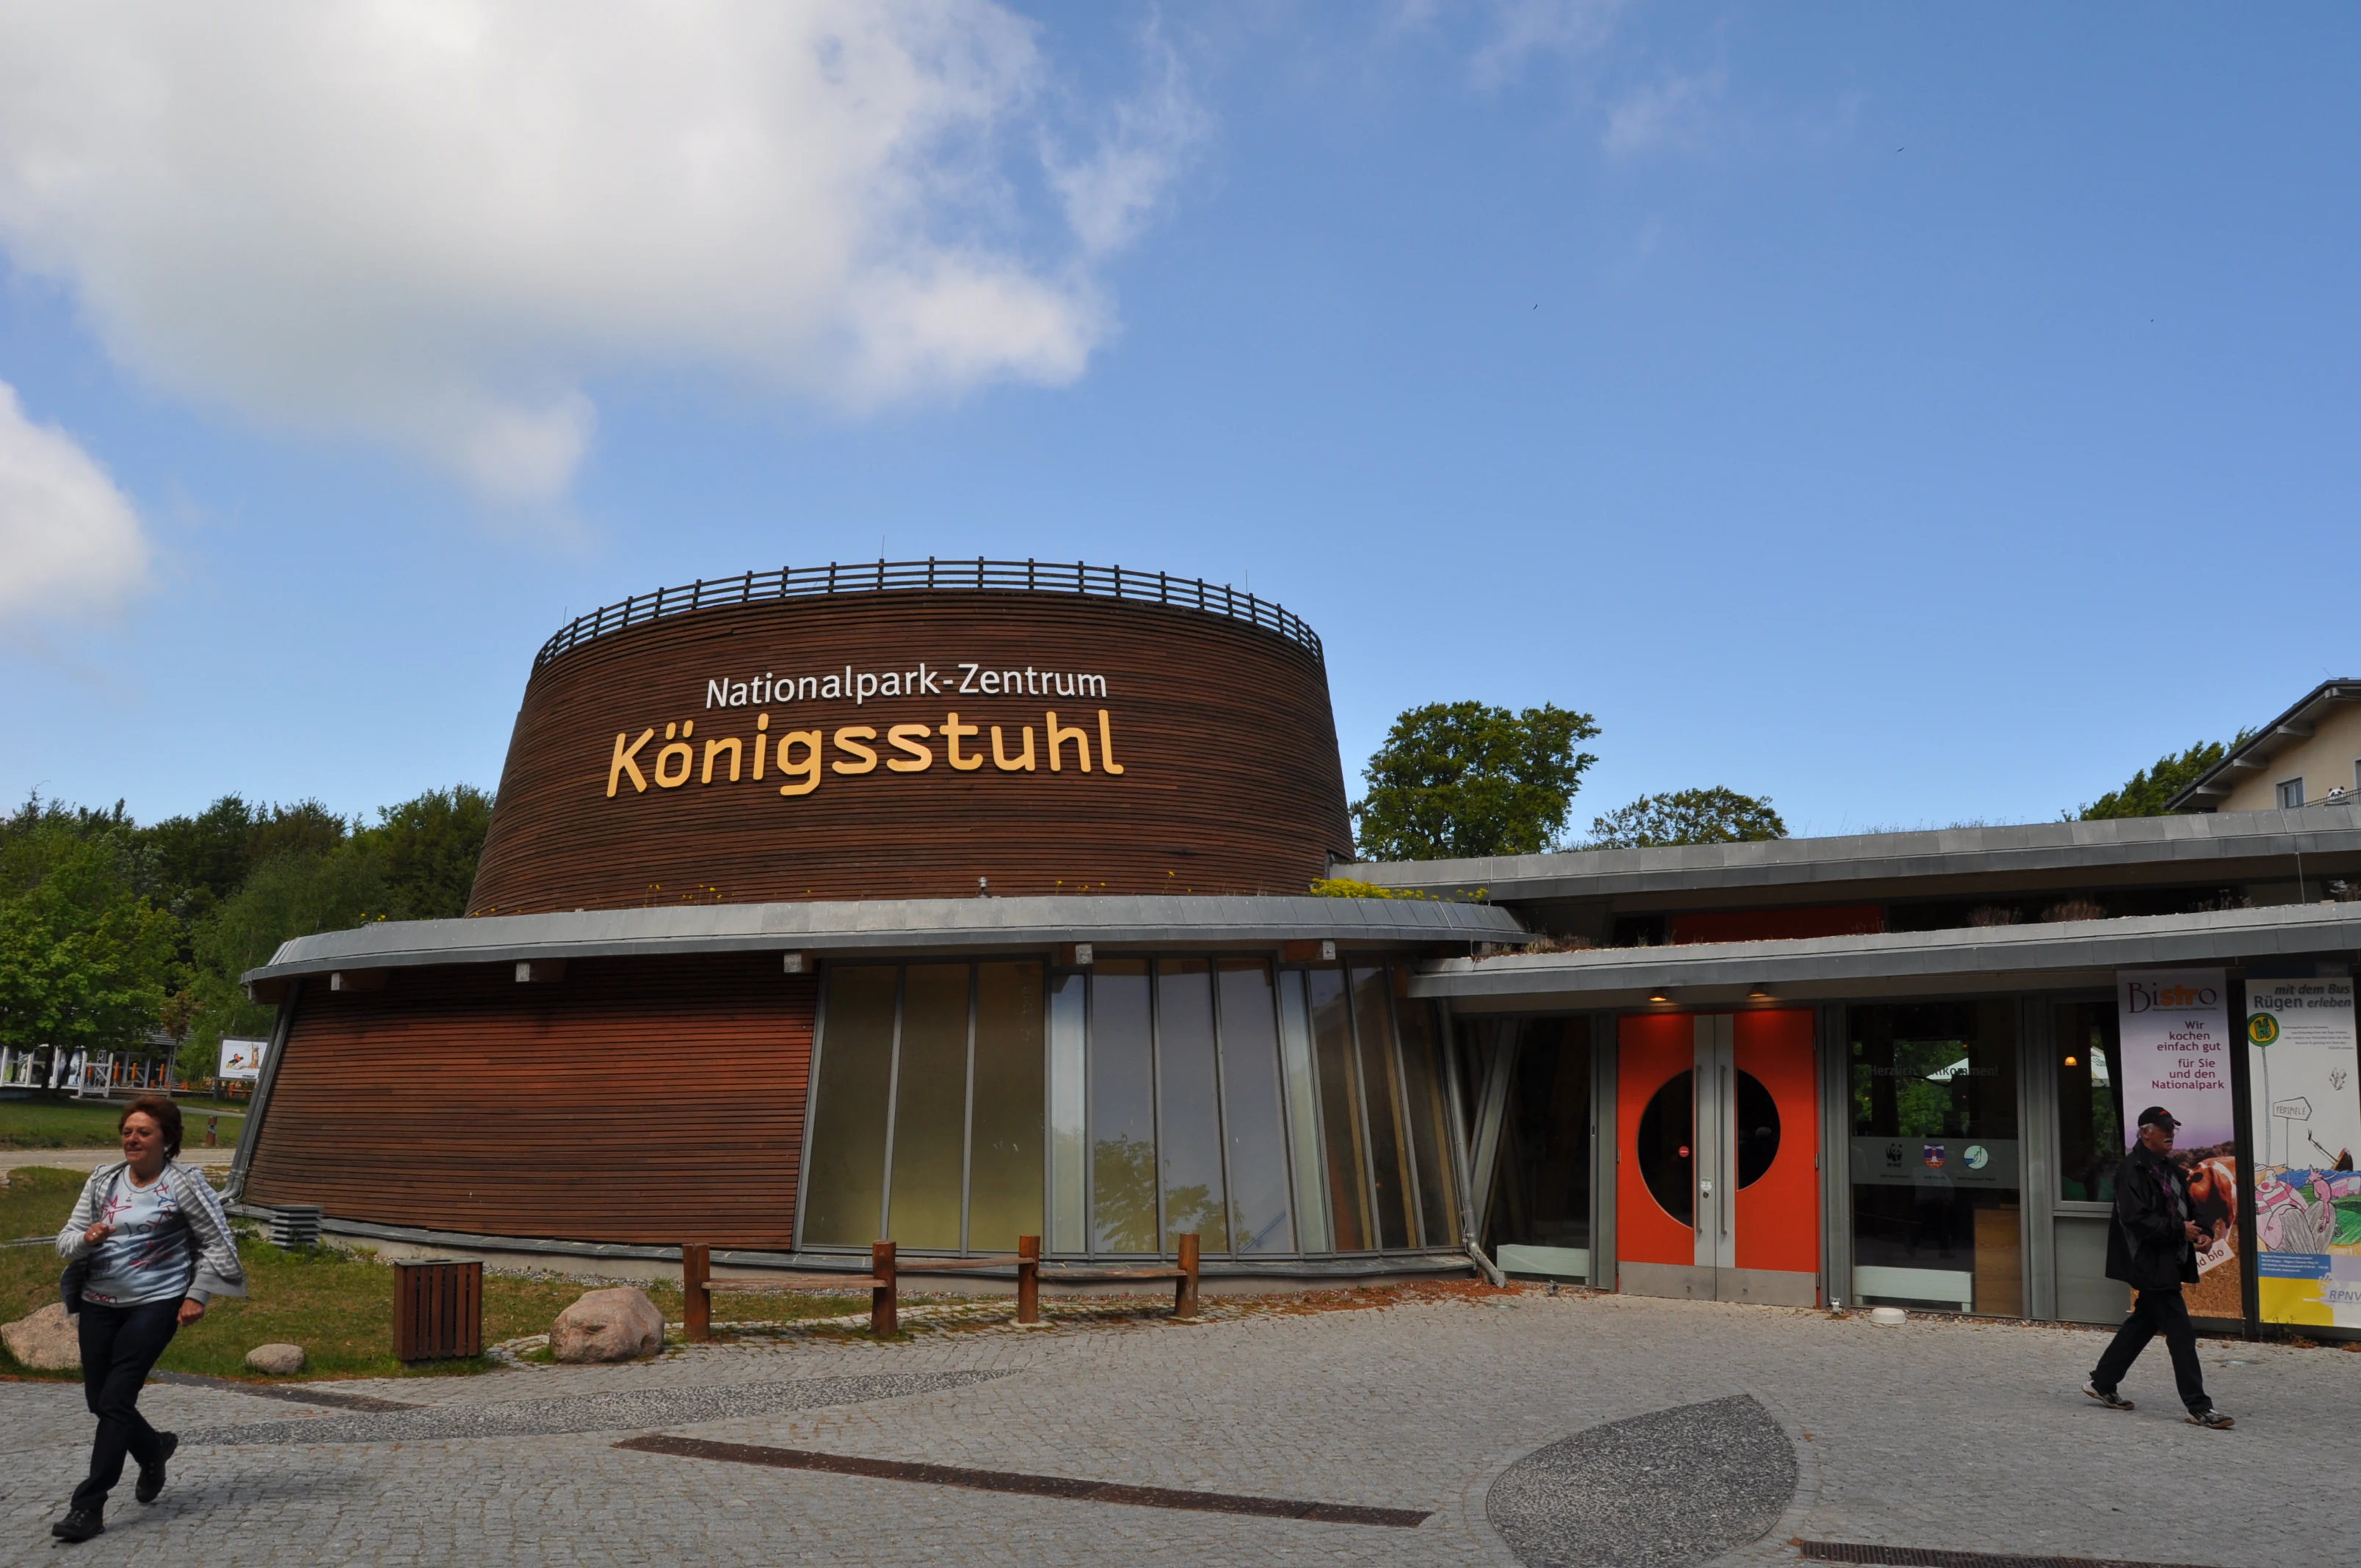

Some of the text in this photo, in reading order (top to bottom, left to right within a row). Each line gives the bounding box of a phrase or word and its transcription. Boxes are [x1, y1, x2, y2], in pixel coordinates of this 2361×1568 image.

[706, 663, 1108, 709] Nationalpark-Zentrum
[605, 708, 1125, 798] Königsstuhl
[2274, 984, 2351, 995] mit dem Bus
[2127, 981, 2218, 1014] Bistro
[2253, 995, 2352, 1012] Rügen erleben
[2184, 1020, 2205, 1031] Wir
[2169, 1031, 2211, 1041] kochen
[2156, 1042, 2222, 1053] einfach gut
[2177, 1058, 2216, 1068] für Sie
[1871, 1063, 1998, 1076] Herzlich llkommen!
[2169, 1069, 2216, 1079] und den
[2151, 1080, 2225, 1091] Nationalpark
[2276, 1105, 2307, 1116] FESTSPIELE
[2208, 1249, 2224, 1262] bio
